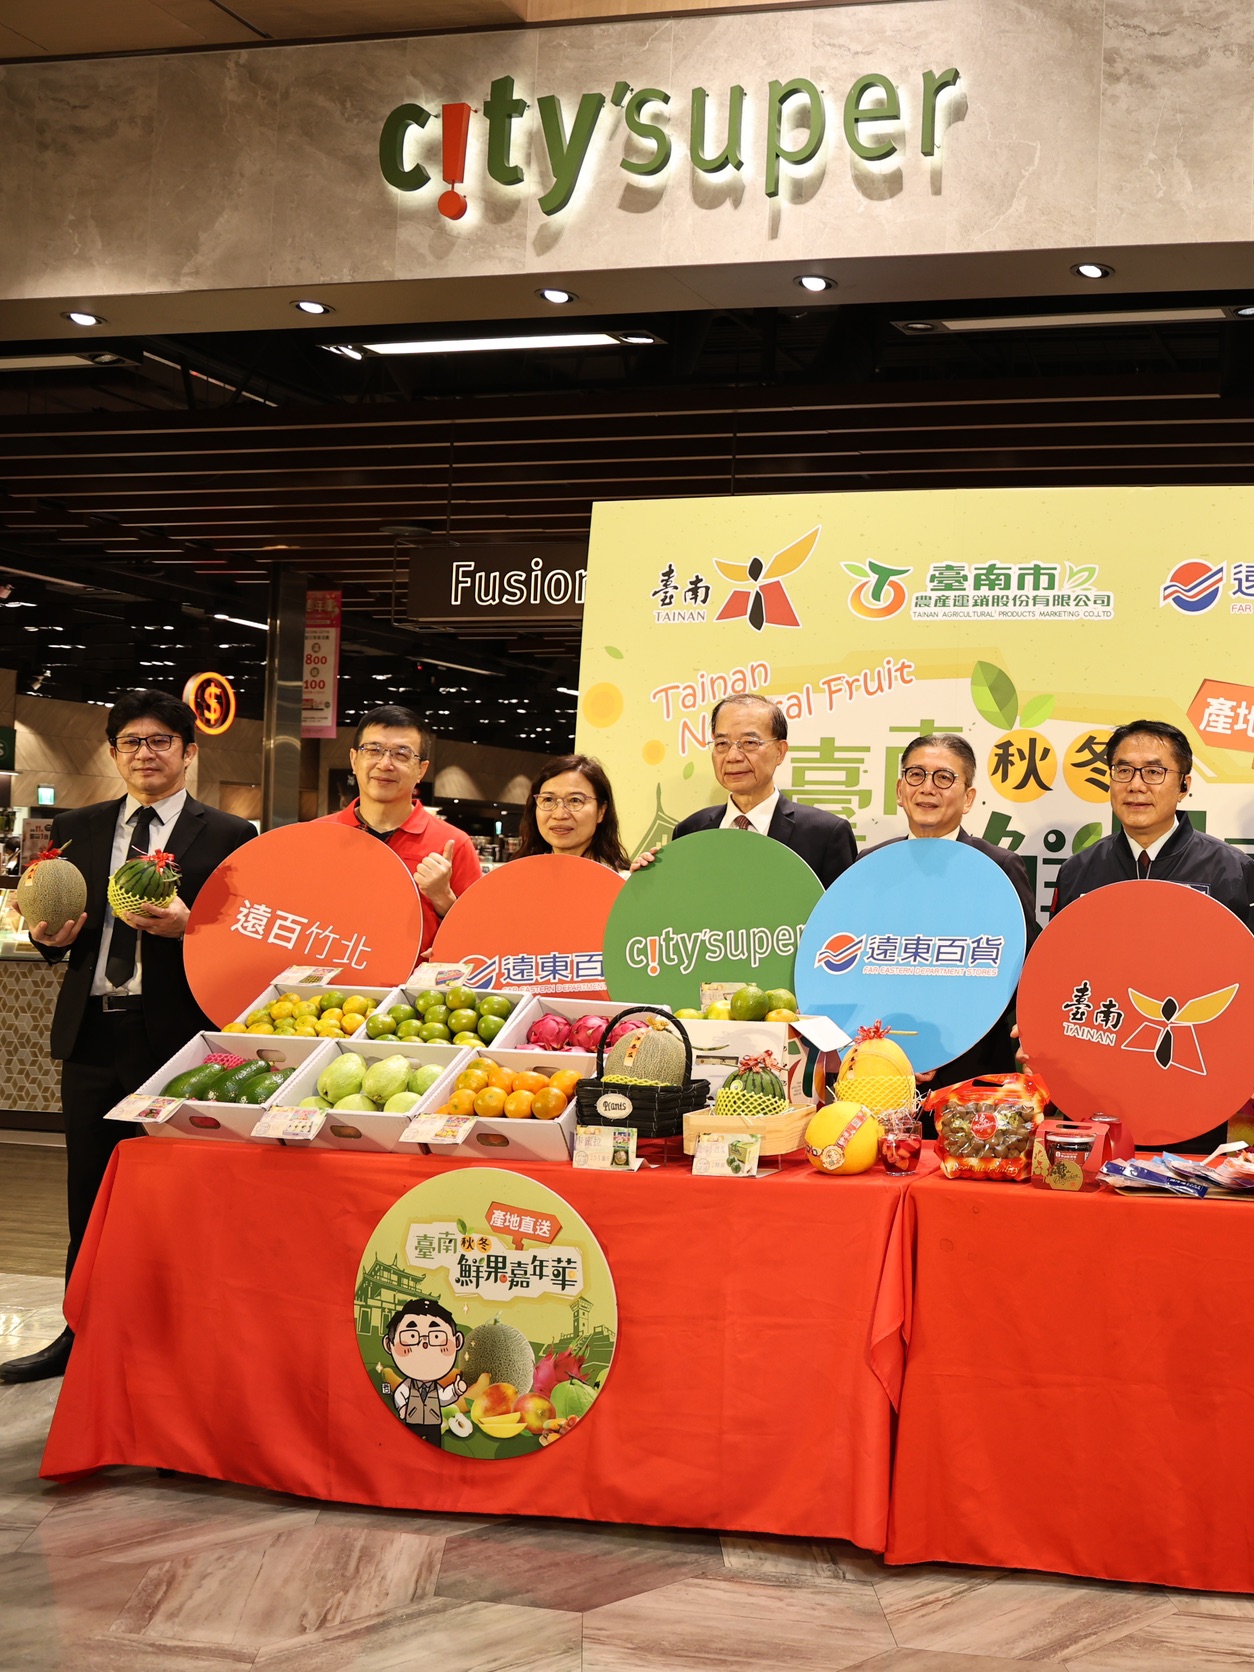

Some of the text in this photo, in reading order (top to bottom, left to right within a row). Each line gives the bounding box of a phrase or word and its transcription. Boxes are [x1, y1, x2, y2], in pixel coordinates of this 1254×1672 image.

[652, 563, 711, 607] 臺南
[929, 563, 1058, 592] 臺南市
[913, 610, 939, 618] TAINAN
[942, 610, 995, 618] AGRICULTURAL
[998, 610, 1036, 618] PRODUCTS
[1039, 610, 1080, 618] MARKETING
[914, 594, 1111, 608] 農產運銷股份有限公司
[1231, 604, 1252, 613] FAR
[655, 611, 706, 622] TAINAN
[305, 653, 328, 665] 800
[303, 680, 326, 690] 100
[653, 661, 769, 720] Tainan
[822, 659, 914, 711] Fruit
[230, 899, 372, 970] 遠百竹北
[866, 935, 1003, 965] 遠東百貨
[863, 966, 998, 976] FAR EASTERN DEPARTMENT STORES
[1063, 981, 1124, 1030] 臺南
[1063, 1023, 1116, 1047] TAINAN
[490, 1209, 552, 1238] 產地直送
[454, 1253, 578, 1291] 鮮果嘉年華
